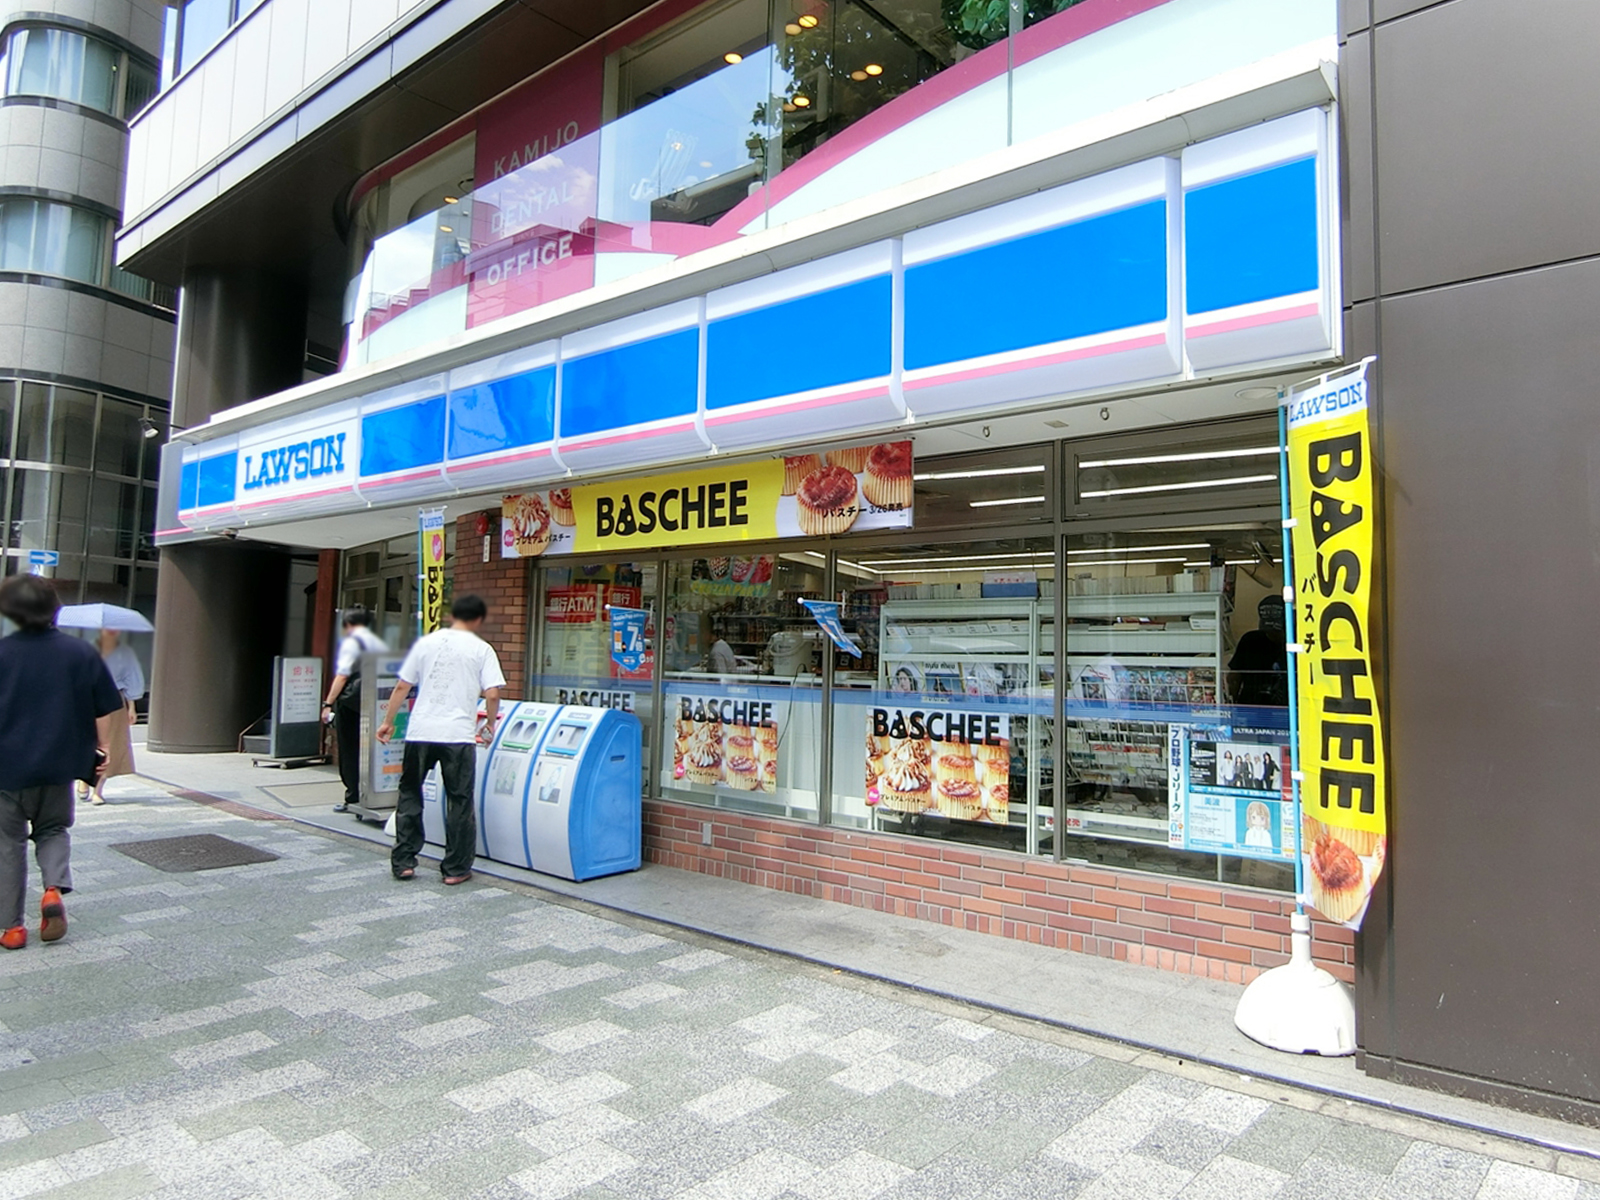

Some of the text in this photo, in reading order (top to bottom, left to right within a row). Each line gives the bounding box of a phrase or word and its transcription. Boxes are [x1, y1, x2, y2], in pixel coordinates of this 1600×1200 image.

[494, 121, 579, 179] KAMIJO
[491, 181, 574, 234] DENTAL
[487, 235, 573, 286] OFFICE
[1290, 382, 1363, 422] LAWSON
[243, 432, 346, 491] LAWSON
[596, 479, 748, 537] BASCHEE
[628, 626, 639, 651] 7
[1302, 572, 1318, 686] バスチー
[1308, 432, 1375, 815] BASCHEE
[681, 697, 772, 728] BASCHEE
[873, 709, 1001, 747] BASCHEE
